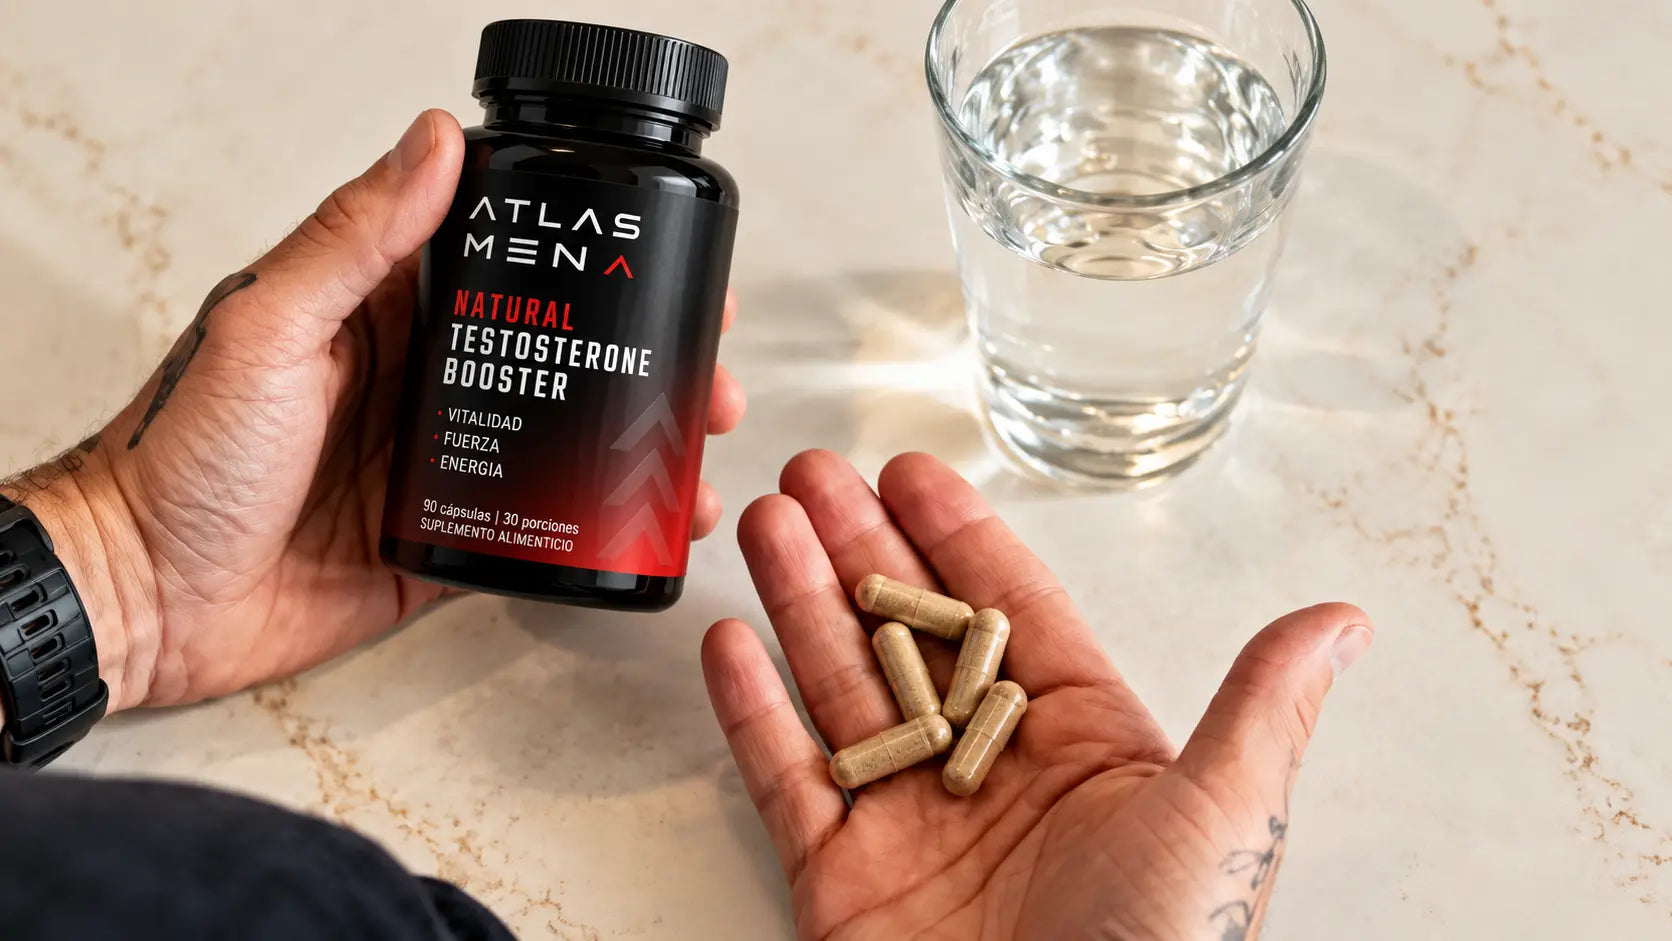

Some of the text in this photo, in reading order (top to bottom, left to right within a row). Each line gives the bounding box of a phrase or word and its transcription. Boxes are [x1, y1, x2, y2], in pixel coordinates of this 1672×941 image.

[469, 196, 641, 240] ATLAS
[453, 289, 574, 331] NATURAL
[451, 323, 652, 377] TESTOSTERONE
[443, 357, 568, 400] BOOSTER
[448, 407, 523, 431] VITALIDAD
[443, 431, 500, 453] FUERZA
[440, 454, 503, 478] ENERGIA
[420, 517, 574, 552] SUPLEMENTO ALIMENTICIO
[423, 498, 438, 513] 90
[440, 503, 491, 523] cápsulas
[502, 512, 519, 526] 30
[521, 518, 579, 535] porciones
